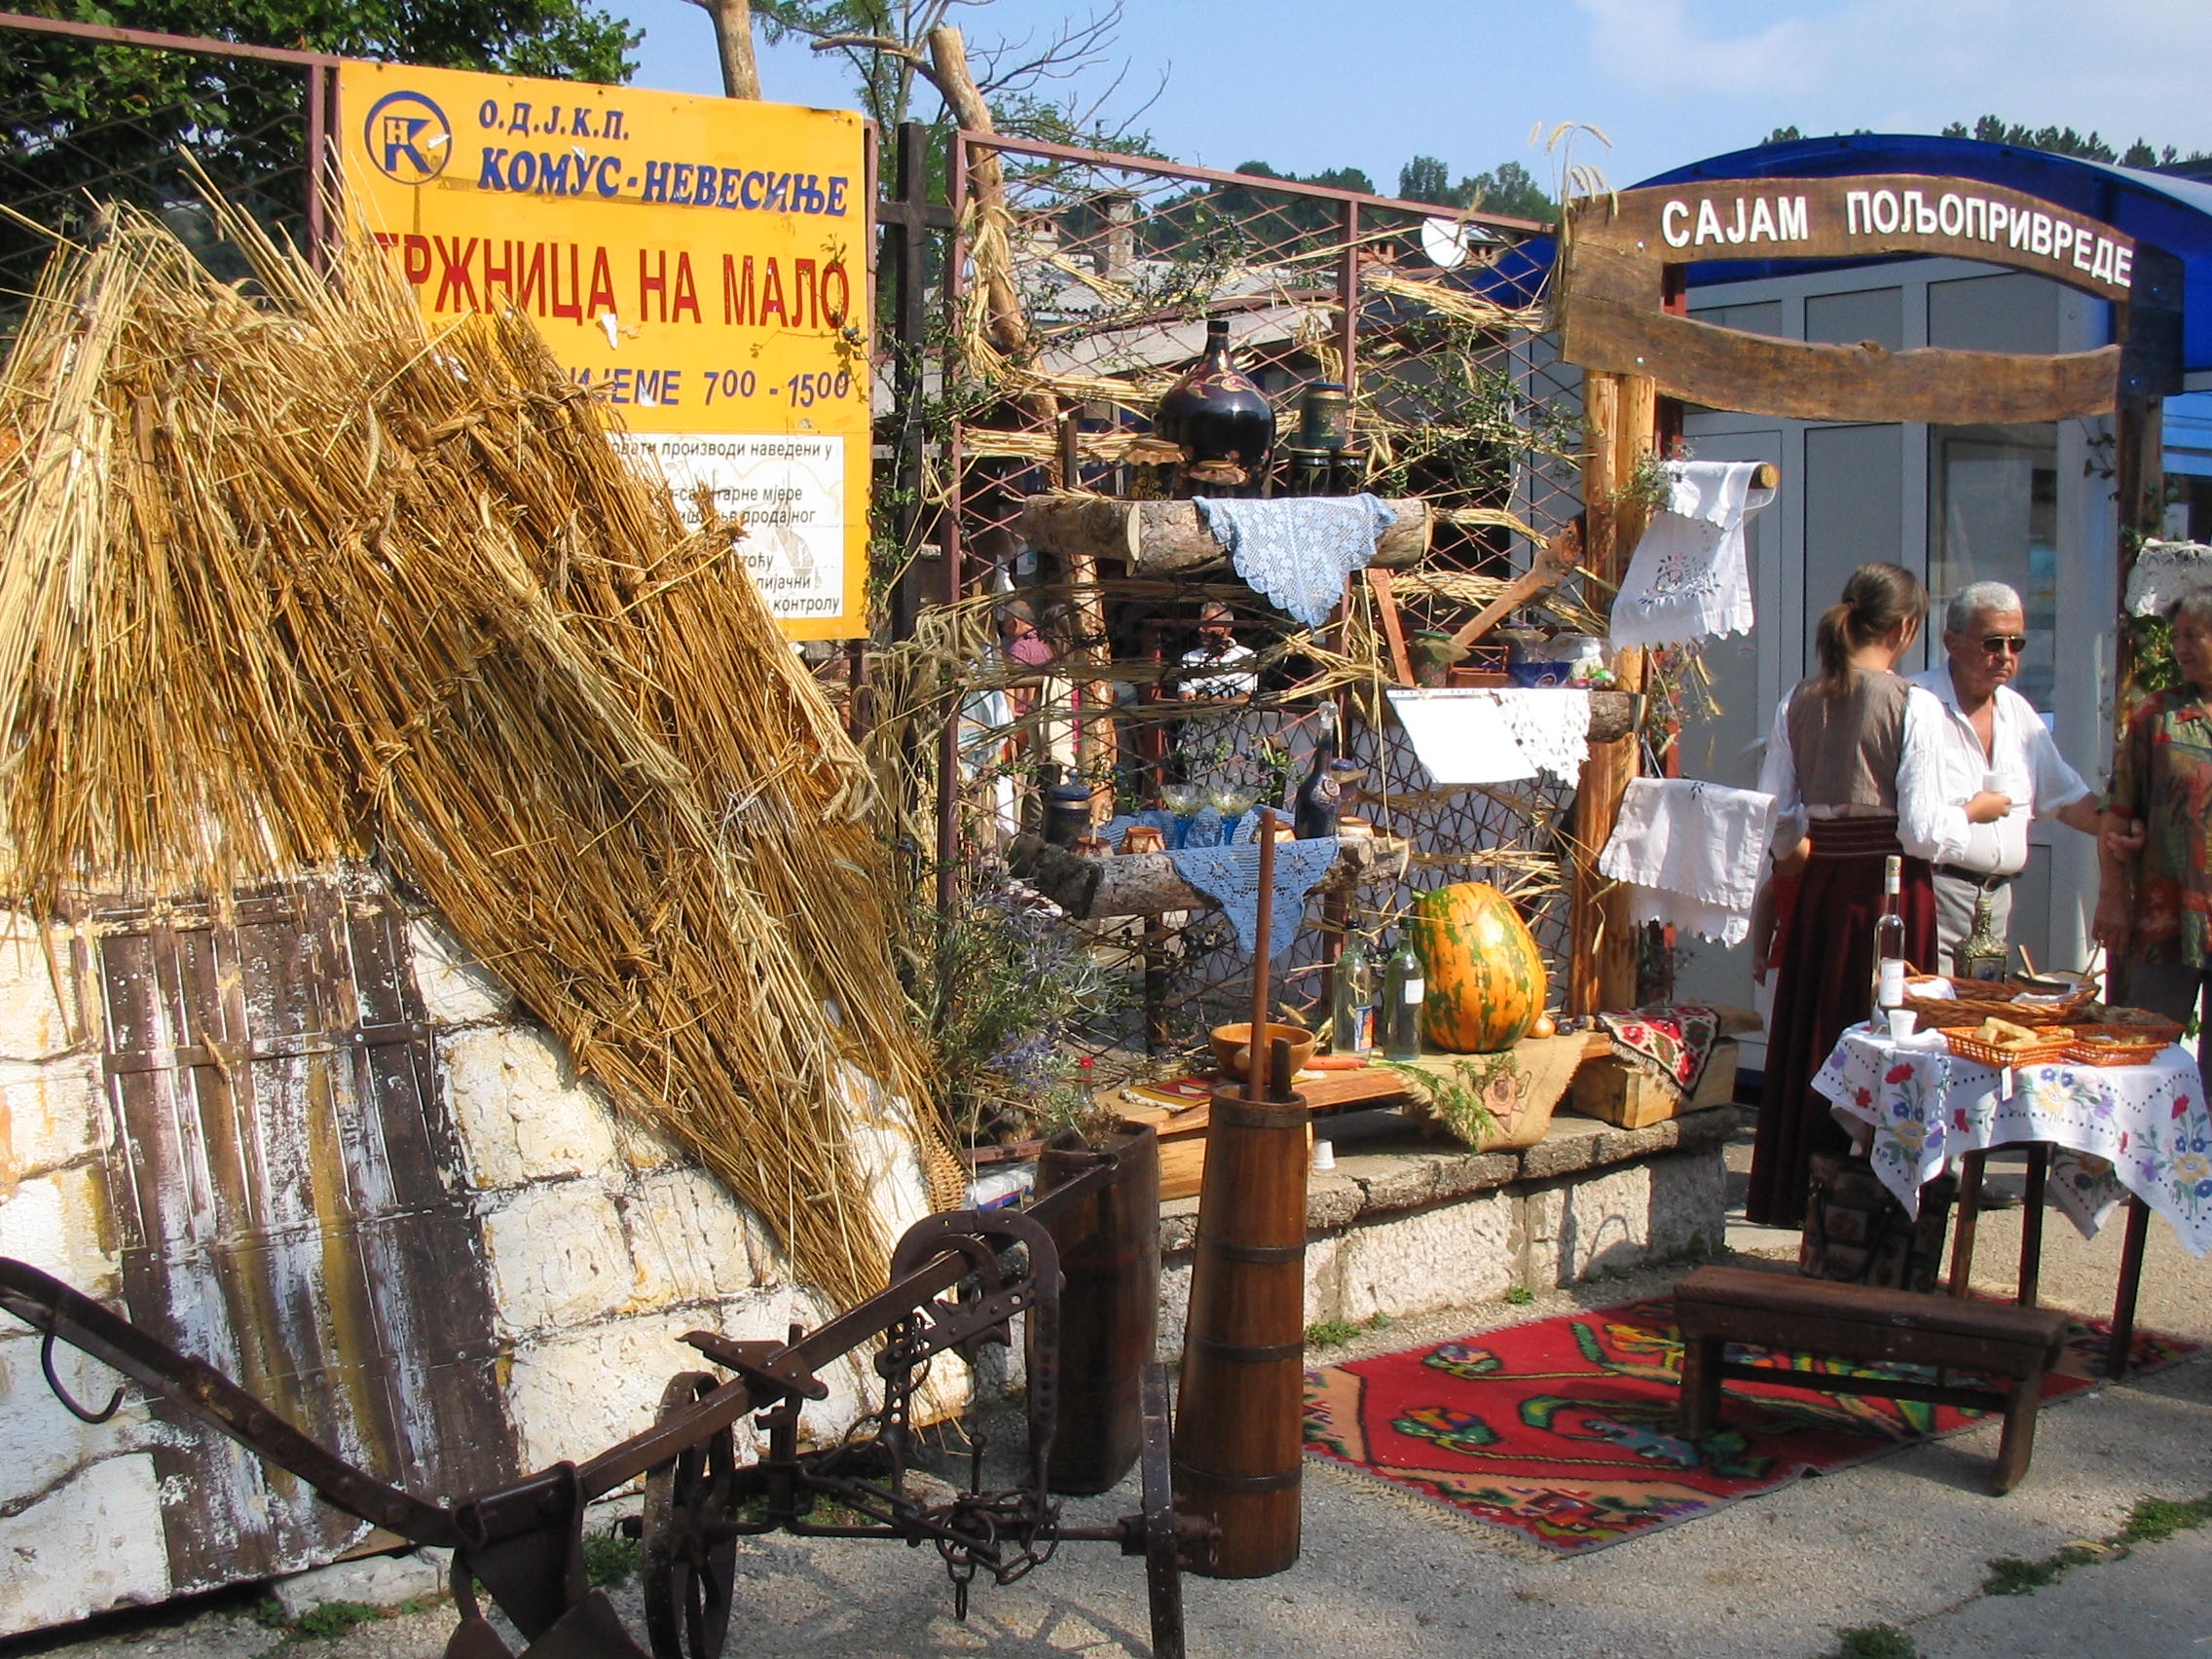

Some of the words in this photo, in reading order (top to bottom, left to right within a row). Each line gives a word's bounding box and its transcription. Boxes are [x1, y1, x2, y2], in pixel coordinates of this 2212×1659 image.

[1660, 195, 1810, 249] САЈАМ
[1846, 189, 2135, 288] ПОЉОПРИВРЕДЕ
[639, 248, 704, 324] НА
[722, 253, 851, 330] МАЛО
[703, 369, 757, 407] 700
[787, 371, 851, 409] 1500
[662, 442, 746, 461] производи
[750, 443, 822, 458] наведени
[824, 444, 833, 461] у
[761, 485, 803, 505] мјере
[743, 505, 816, 529] продајног
[772, 597, 840, 615] контролу
